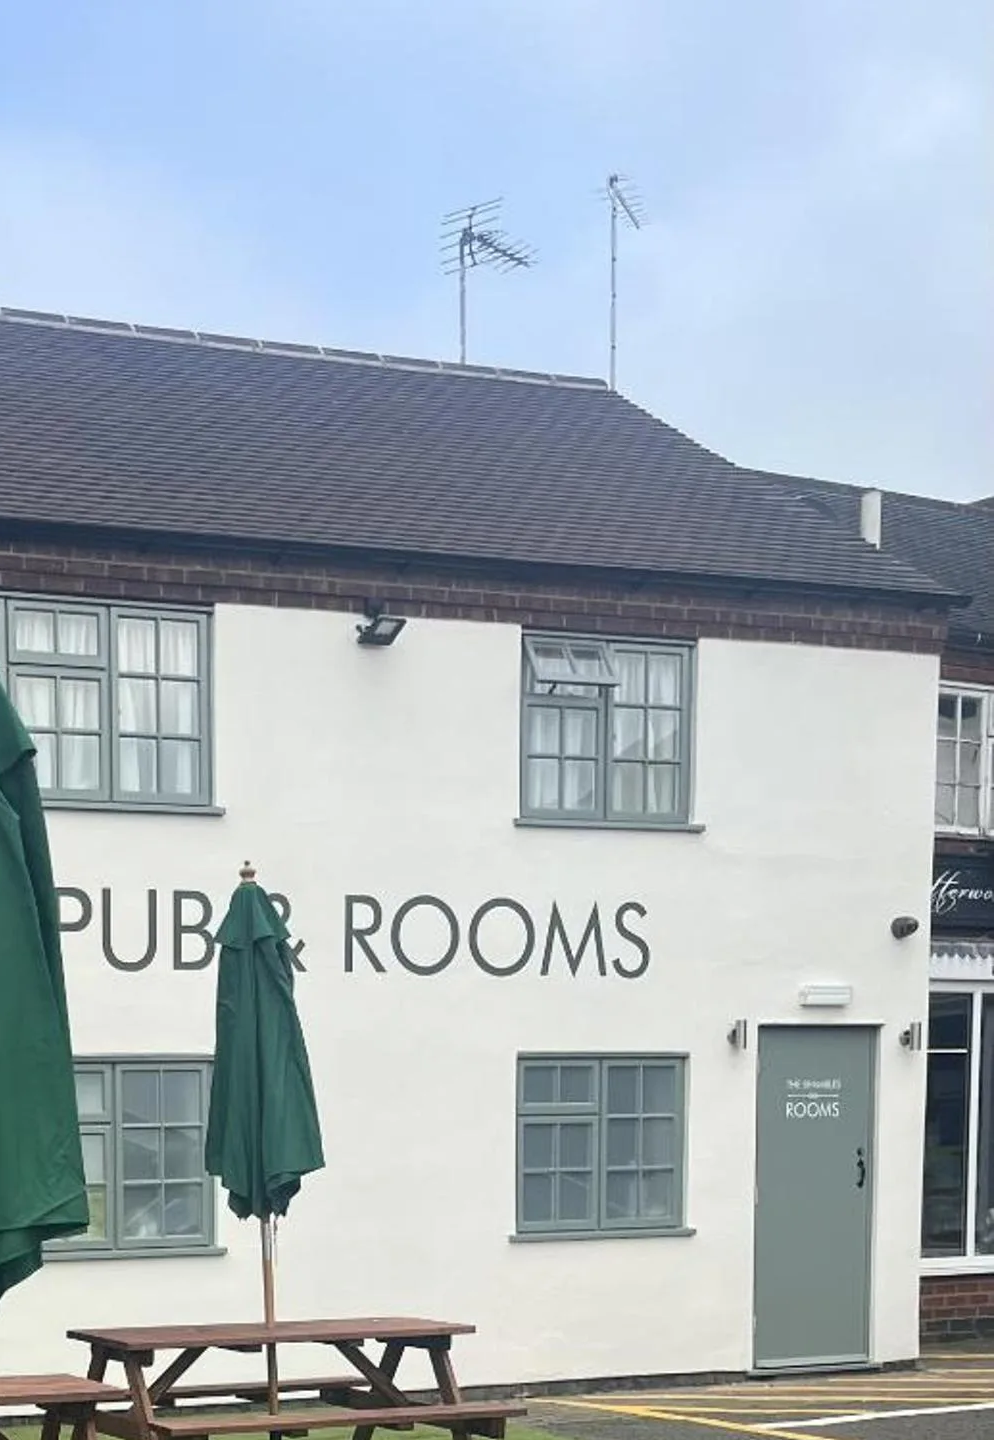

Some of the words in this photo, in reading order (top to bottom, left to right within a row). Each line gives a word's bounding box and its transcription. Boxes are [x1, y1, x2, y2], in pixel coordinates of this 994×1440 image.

[931, 871, 994, 913] fterwo
[55, 886, 217, 973] PUB
[343, 893, 651, 979] ROOMS
[785, 1101, 839, 1118] ROOMS
